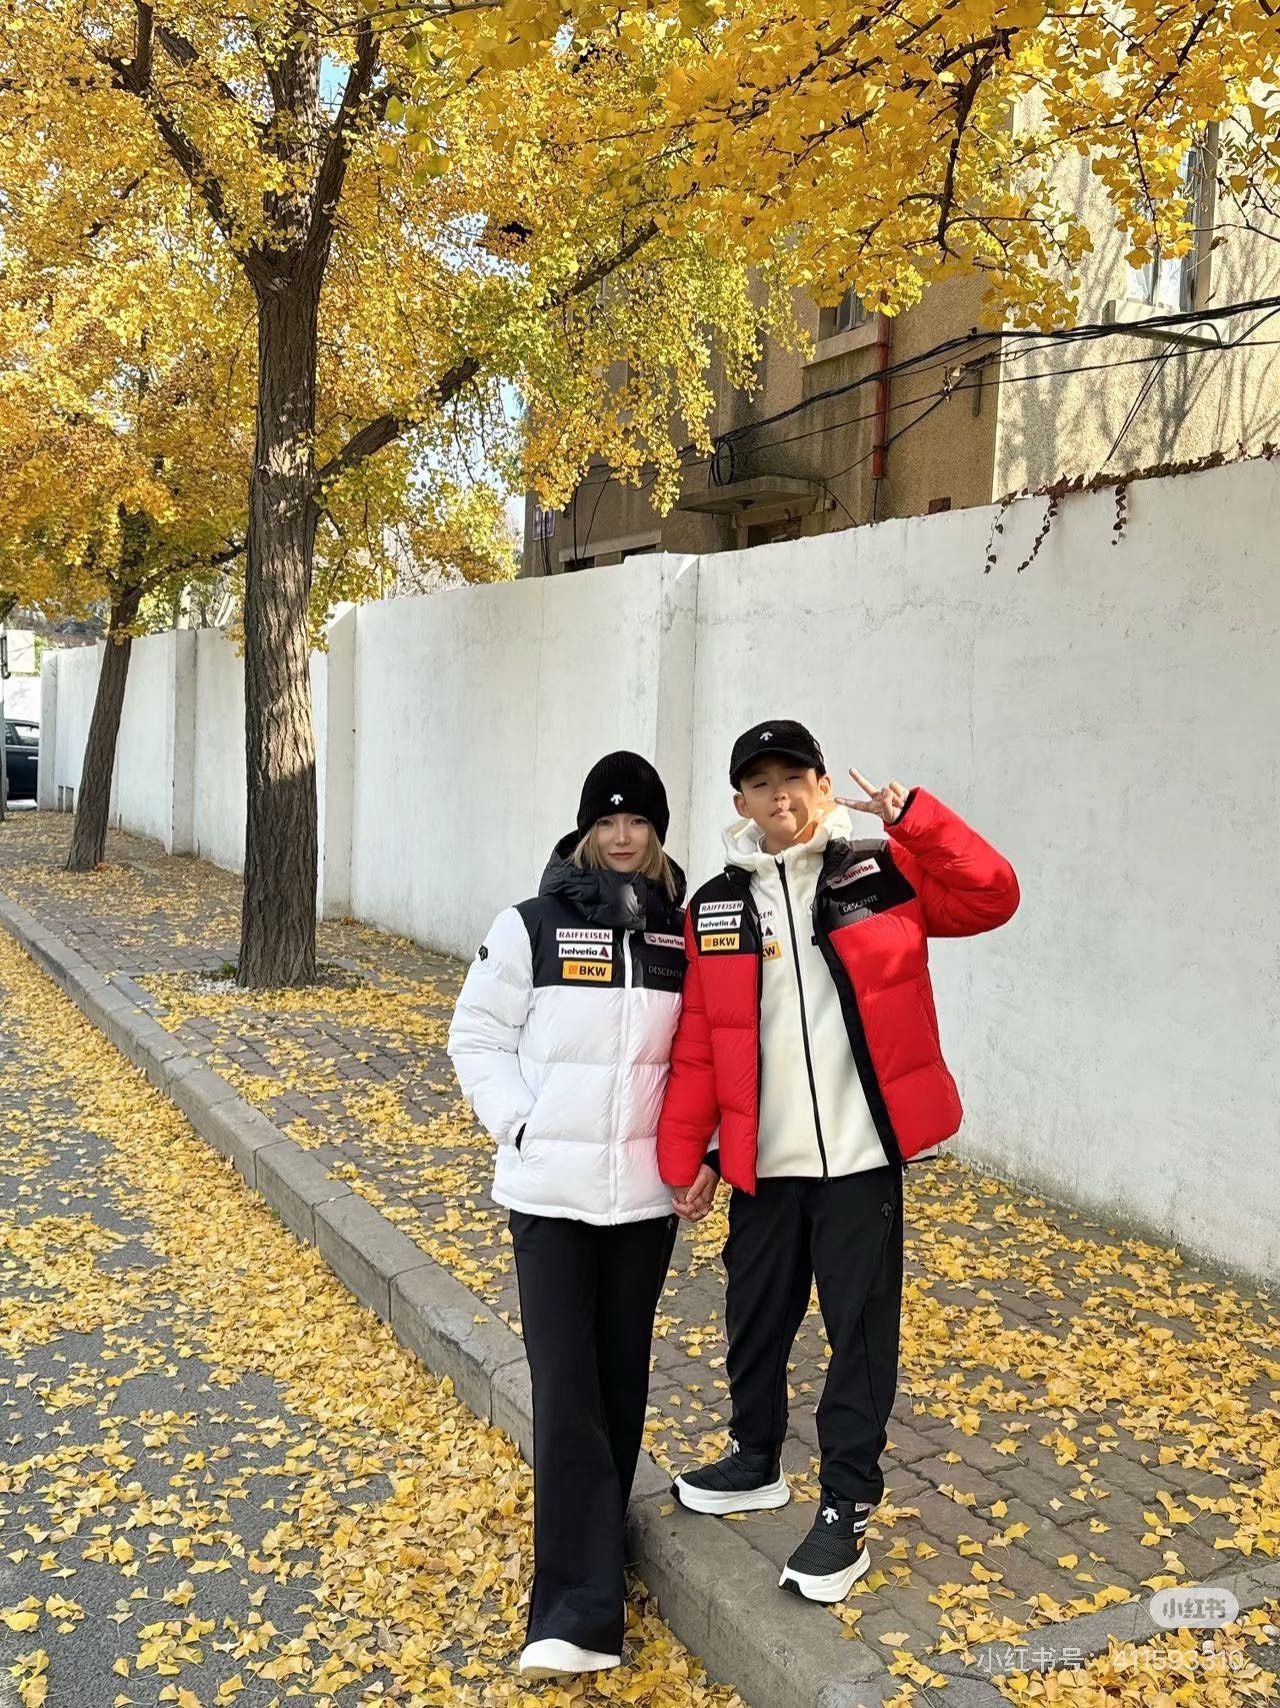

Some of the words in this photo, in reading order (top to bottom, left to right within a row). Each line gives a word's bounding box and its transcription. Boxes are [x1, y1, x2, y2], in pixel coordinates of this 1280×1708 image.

[842, 864, 874, 880] Sunrise
[701, 903, 742, 912] RAIFFEISEN
[842, 895, 879, 912] DESCENTE
[700, 920, 729, 928] helvetia
[558, 930, 611, 940] RAIFFEISEN
[658, 936, 684, 946] Sunrise
[712, 937, 736, 946] BKW
[560, 947, 598, 956] helvetia
[579, 965, 607, 977] BKW
